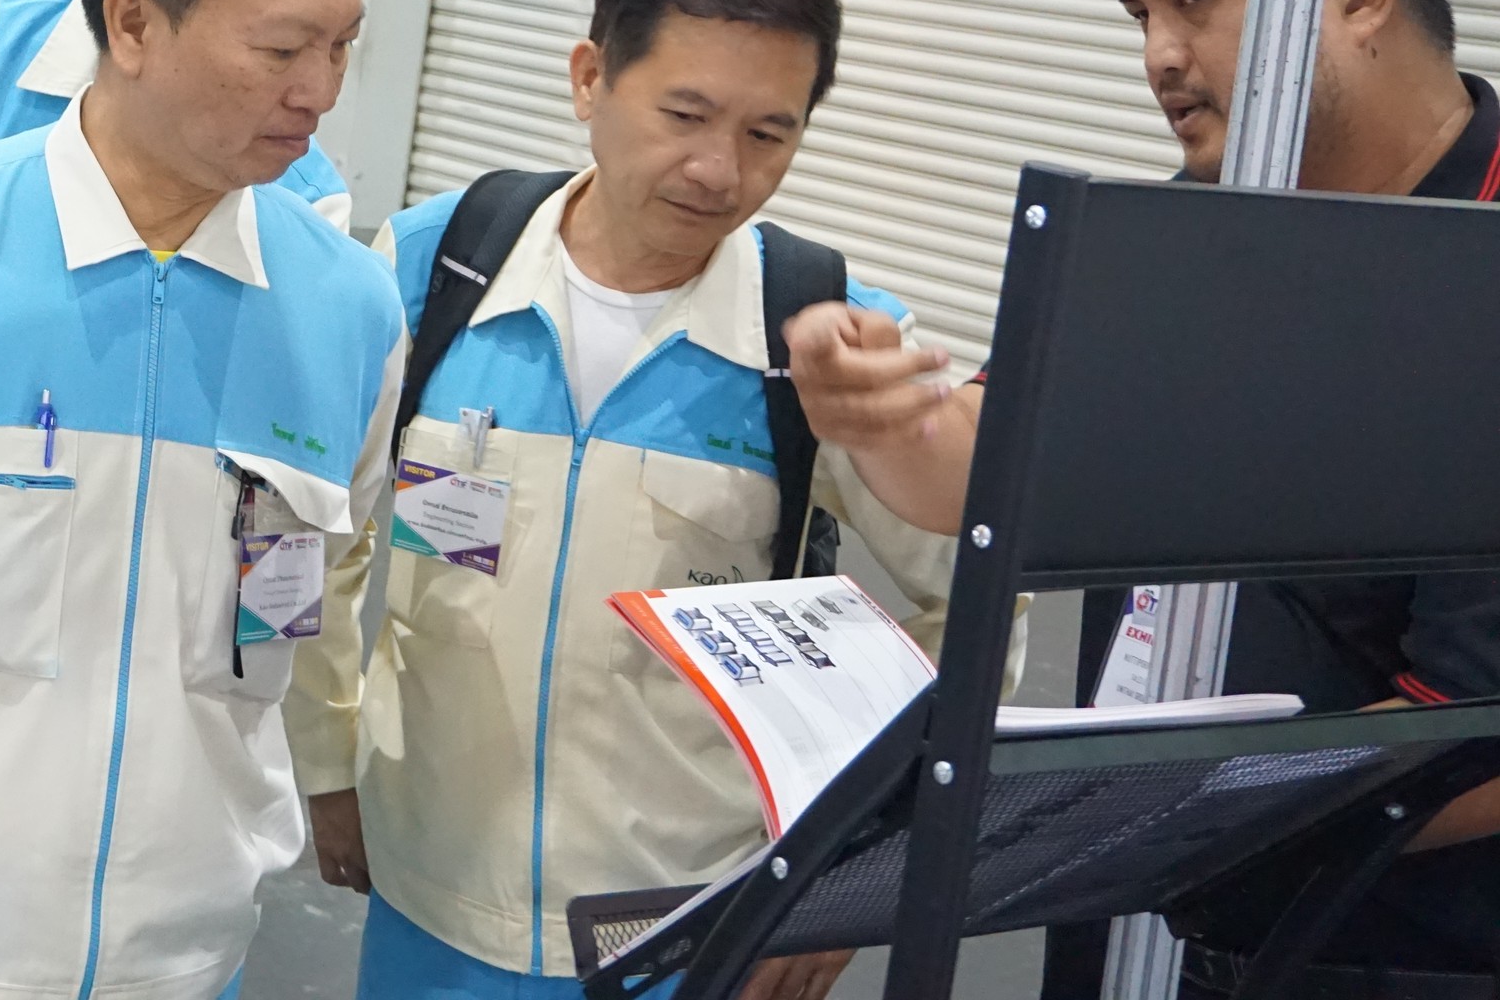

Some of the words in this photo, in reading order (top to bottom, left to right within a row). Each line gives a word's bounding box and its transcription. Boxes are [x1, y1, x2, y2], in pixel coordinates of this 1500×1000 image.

[404, 464, 436, 478] VISITOR
[245, 541, 269, 552] VISITOR
[1125, 626, 1156, 646] EXHI
